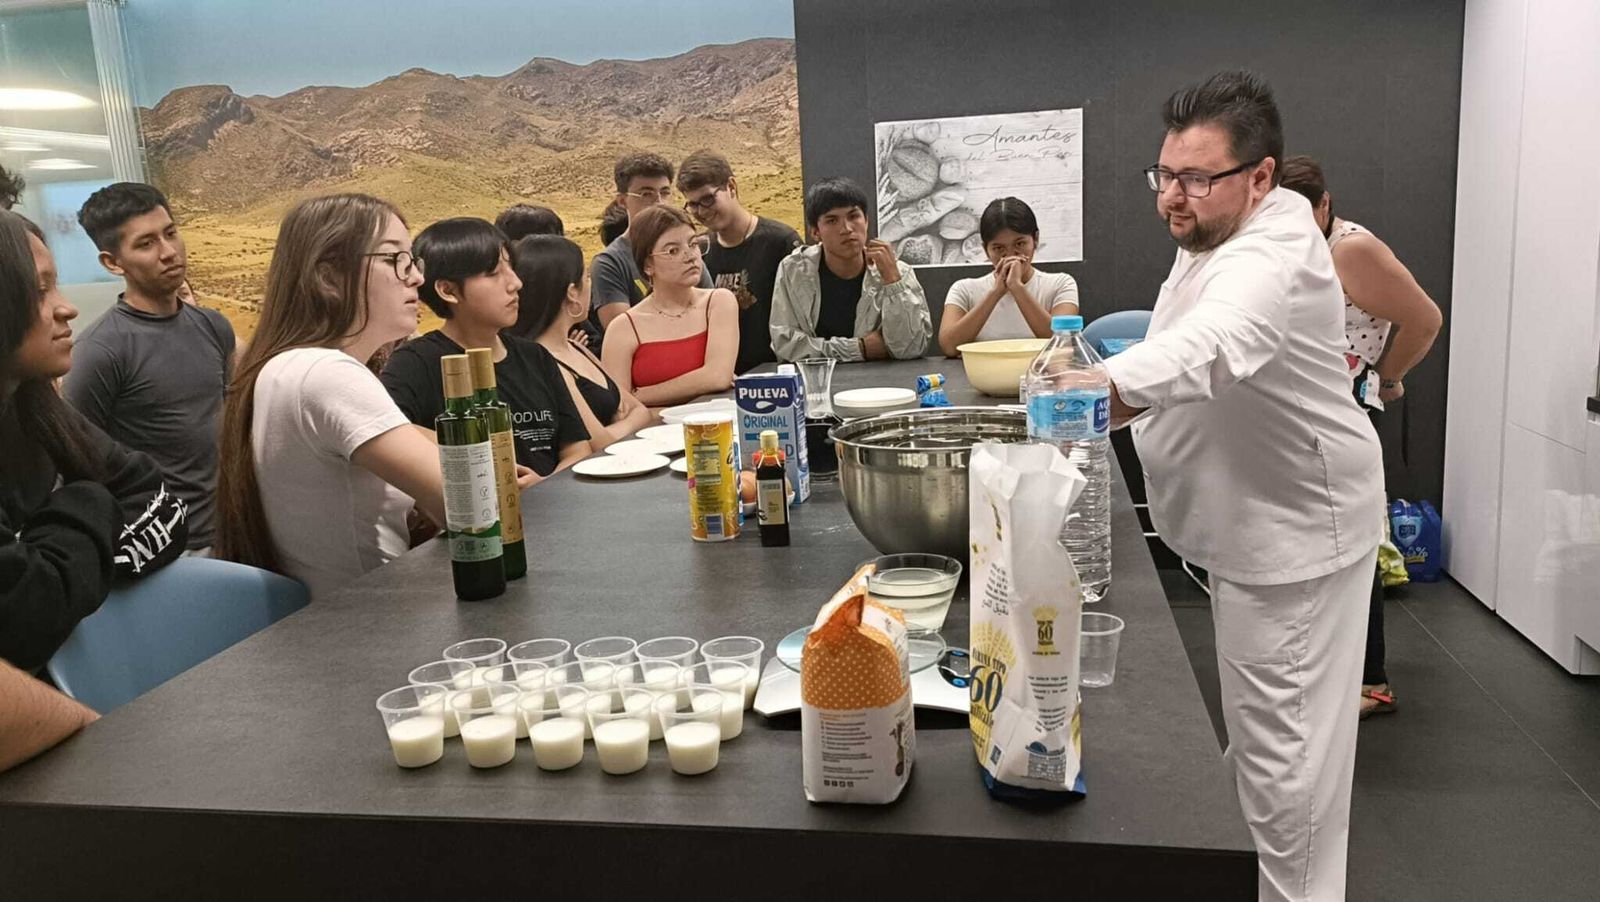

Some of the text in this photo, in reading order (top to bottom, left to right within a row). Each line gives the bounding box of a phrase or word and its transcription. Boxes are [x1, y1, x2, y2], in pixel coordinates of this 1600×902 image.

[963, 124, 1077, 152] Amantes
[738, 387, 789, 399] PULEVA
[743, 415, 788, 429] ORIGINAL
[969, 665, 1003, 713] 60
